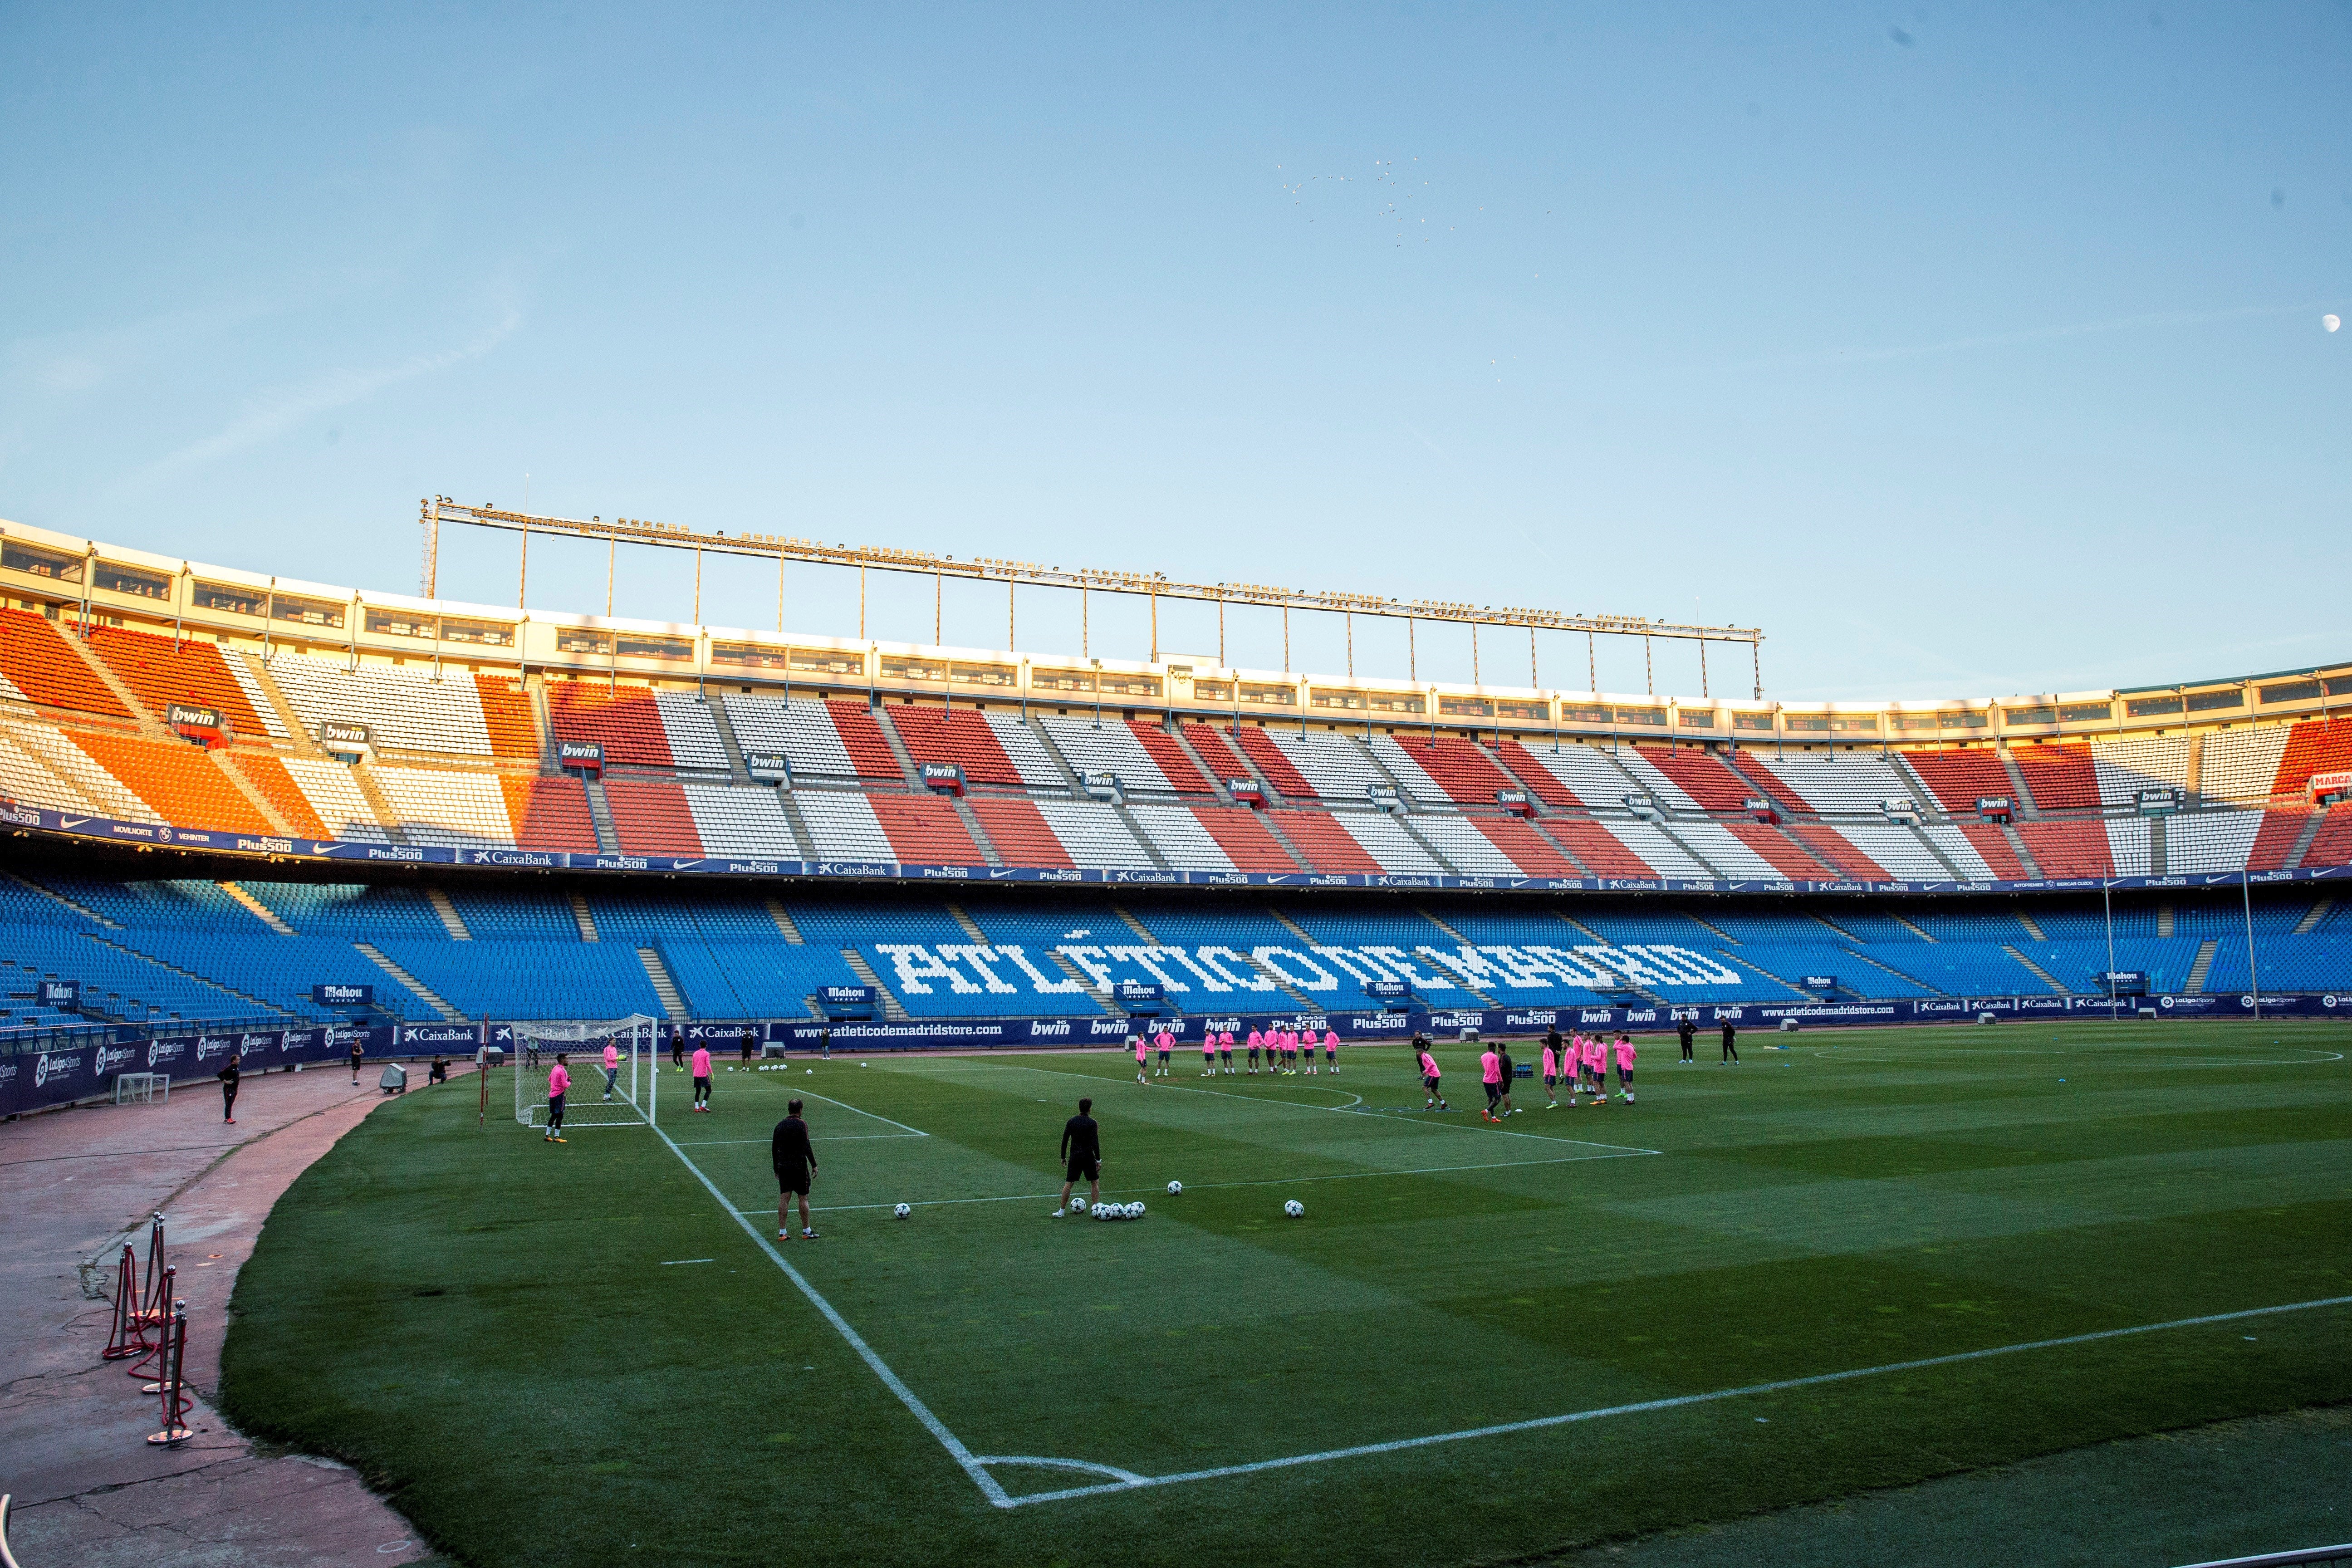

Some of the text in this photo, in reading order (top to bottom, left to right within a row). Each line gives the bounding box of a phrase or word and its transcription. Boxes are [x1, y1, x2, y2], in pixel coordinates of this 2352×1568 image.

[172, 707, 215, 725] bwin
[328, 725, 365, 741] bwin
[562, 744, 599, 758] bwin
[751, 755, 784, 768] bwin
[926, 765, 956, 777] bwin
[1231, 780, 1258, 791] bwin
[2315, 775, 2351, 785] MARCA
[1371, 786, 1396, 796] bwin
[1502, 792, 1525, 801] bwin
[2142, 791, 2171, 800] bwin
[1628, 795, 1651, 806] bwin
[1747, 799, 1769, 808] bwin
[1981, 798, 2008, 808] bwin
[114, 825, 152, 836] MOVILNORTE
[178, 833, 210, 842] VEHINTER
[238, 839, 292, 852] Plus500
[369, 848, 422, 860] Plus500
[492, 852, 552, 865] CaixaBank
[597, 859, 647, 868] Plus500
[730, 863, 778, 873] Plus500
[834, 863, 886, 875] CaixaBank
[924, 869, 968, 877] Plus500
[1040, 872, 1082, 881] Plus500
[1130, 872, 1176, 882] CaixaBank
[2250, 873, 2292, 882] Plus500
[1209, 875, 1248, 883] Plus500
[1310, 877, 1347, 885] Plus500
[1390, 877, 1430, 886] CaixaBank
[1620, 881, 1657, 889] CaixaBank
[1808, 976, 1831, 985] Mahou
[47, 983, 72, 999] Mahou
[324, 986, 363, 998] Mahou
[828, 987, 865, 997] Mahou
[1123, 985, 1155, 995] Mahou
[1375, 982, 1404, 992] Mahou
[1581, 1009, 1611, 1023] bwin
[1627, 1009, 1656, 1021] bwin
[1714, 1006, 1742, 1019] bwin
[1762, 1005, 1894, 1017] www.atleticodemadridstore.com
[1205, 1018, 1240, 1031] bwin
[1353, 1019, 1406, 1029] Plus500
[1432, 1016, 1482, 1027] Plus500
[1507, 1015, 1556, 1025] Plus500
[1031, 1020, 1070, 1035] bwin
[1091, 1019, 1129, 1034] bwin
[1148, 1019, 1185, 1034] bwin
[420, 1029, 473, 1040] CaixaBank
